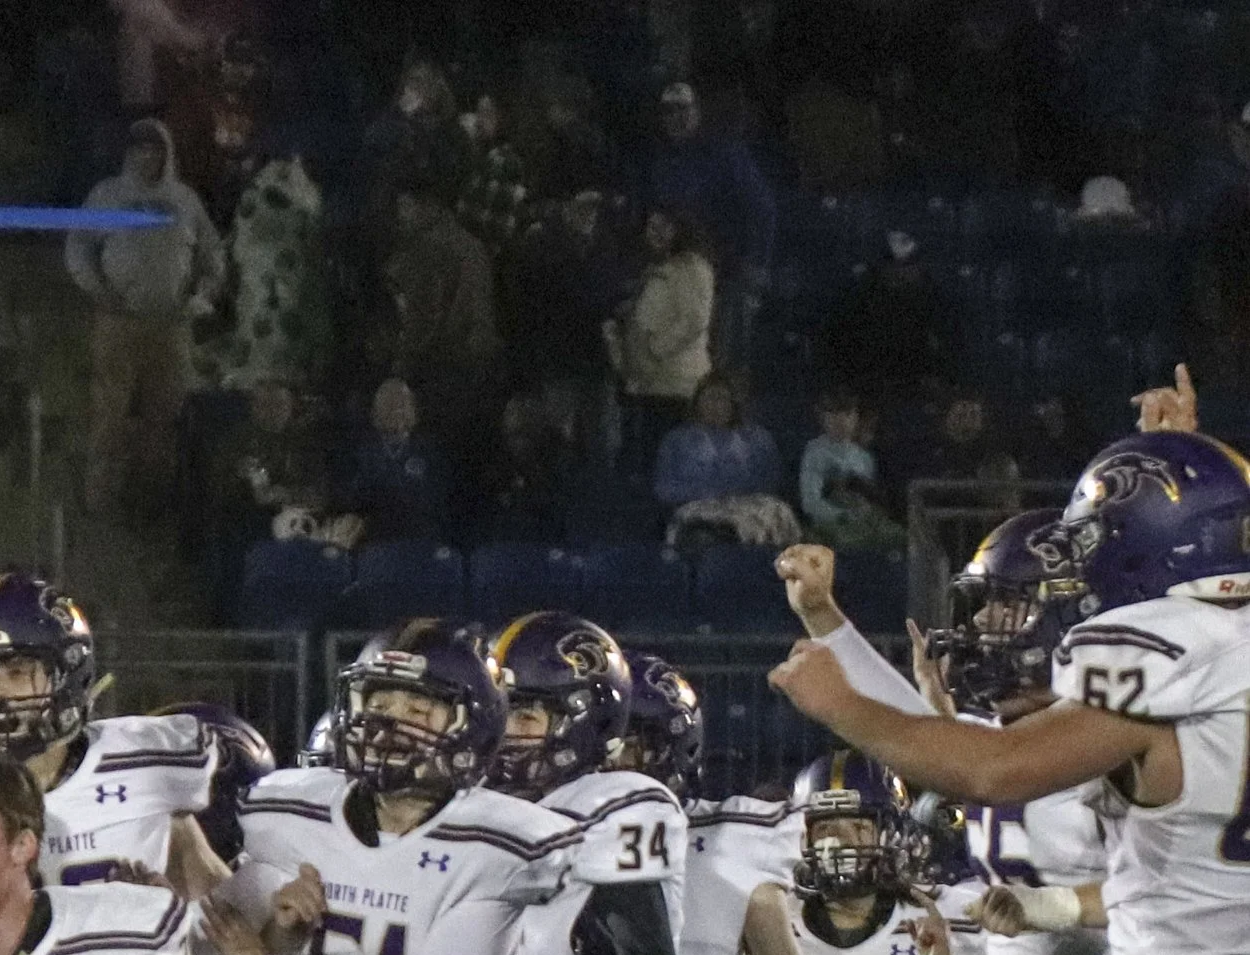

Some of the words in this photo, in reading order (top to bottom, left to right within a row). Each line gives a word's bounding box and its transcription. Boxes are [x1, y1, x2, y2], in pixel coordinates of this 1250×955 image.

[1083, 666, 1150, 722] 62
[48, 831, 96, 855] PLATTE
[616, 821, 669, 871] 34
[361, 888, 410, 913] PLATTE
